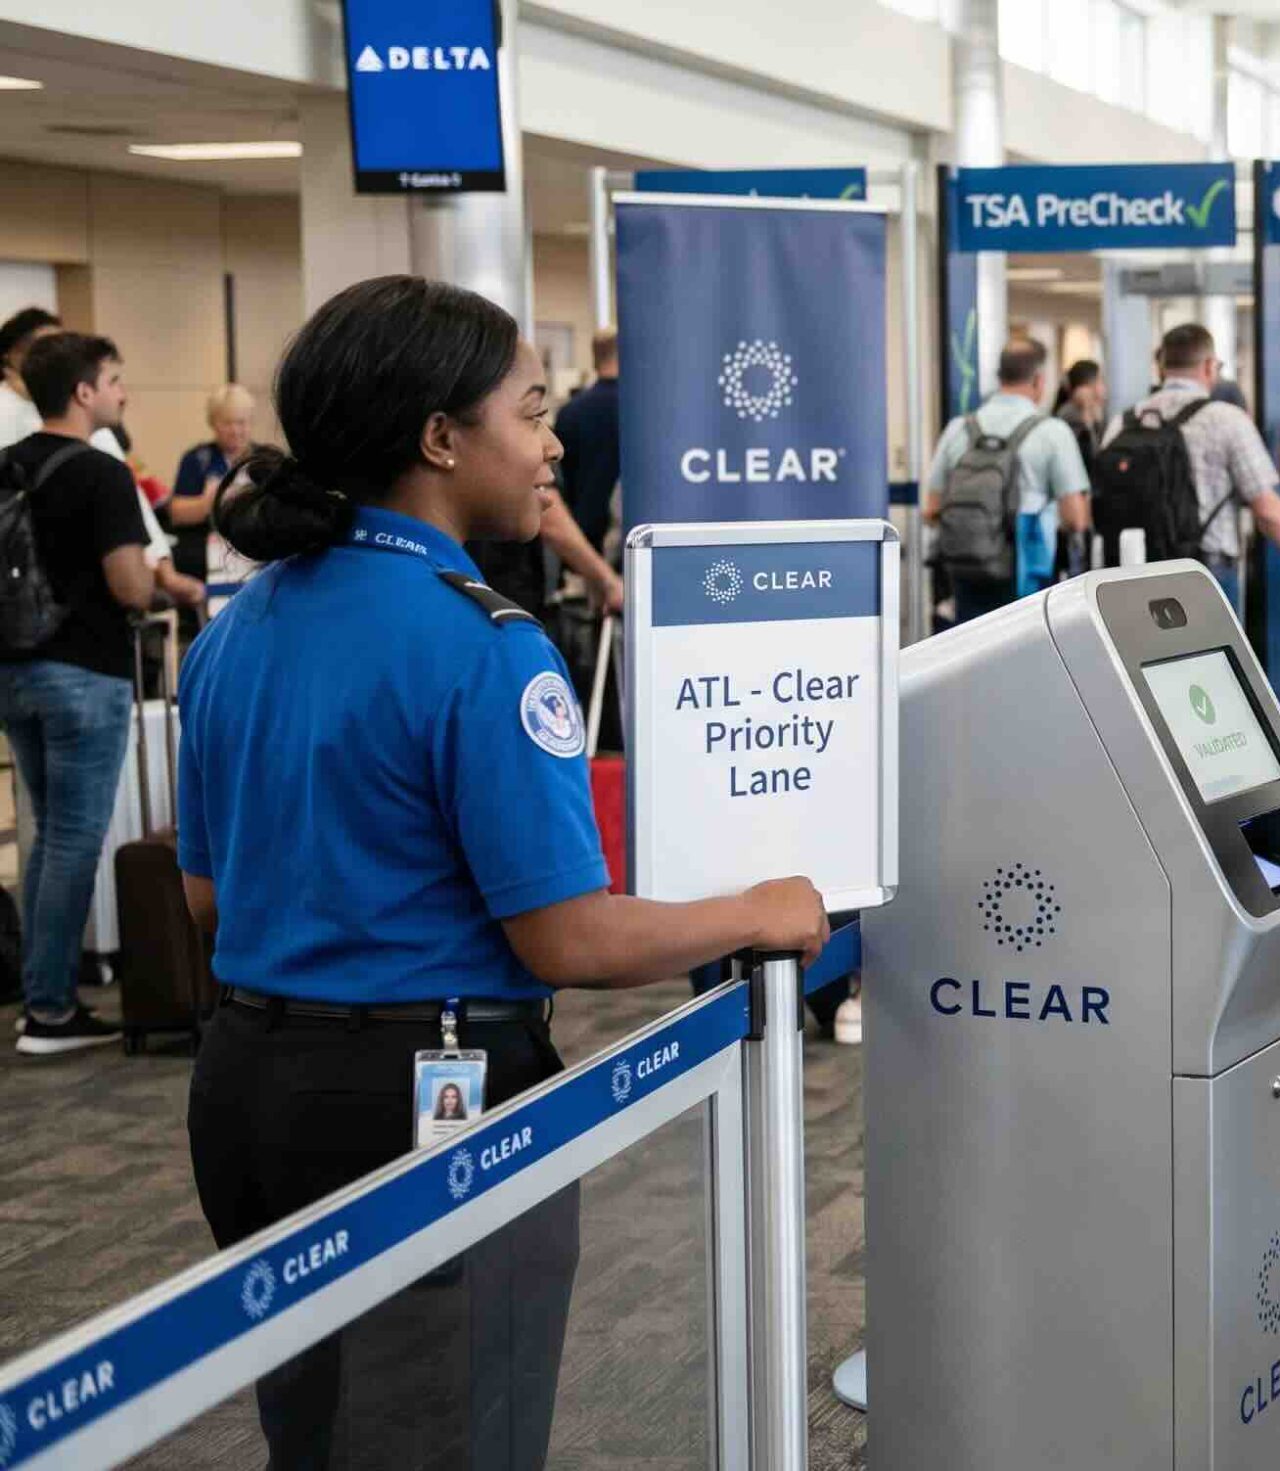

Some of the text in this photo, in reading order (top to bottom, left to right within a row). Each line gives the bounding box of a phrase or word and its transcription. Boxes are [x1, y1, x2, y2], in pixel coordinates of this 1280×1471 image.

[388, 46, 491, 71] DELTA
[966, 191, 1185, 229] TSA PreCheck
[680, 448, 838, 483] CLEAR
[375, 532, 428, 556] CLEAR
[753, 570, 833, 592] CLEAR
[675, 677, 741, 711] ATL
[772, 668, 860, 704] Clear
[705, 713, 835, 755] Priority
[730, 766, 812, 798] Lane
[929, 977, 1110, 1025] CLEAR
[637, 1041, 680, 1079] CLEAR
[480, 1126, 532, 1171] CLEAR
[282, 1229, 349, 1285] CLEAR
[28, 1360, 115, 1431] CLEAR
